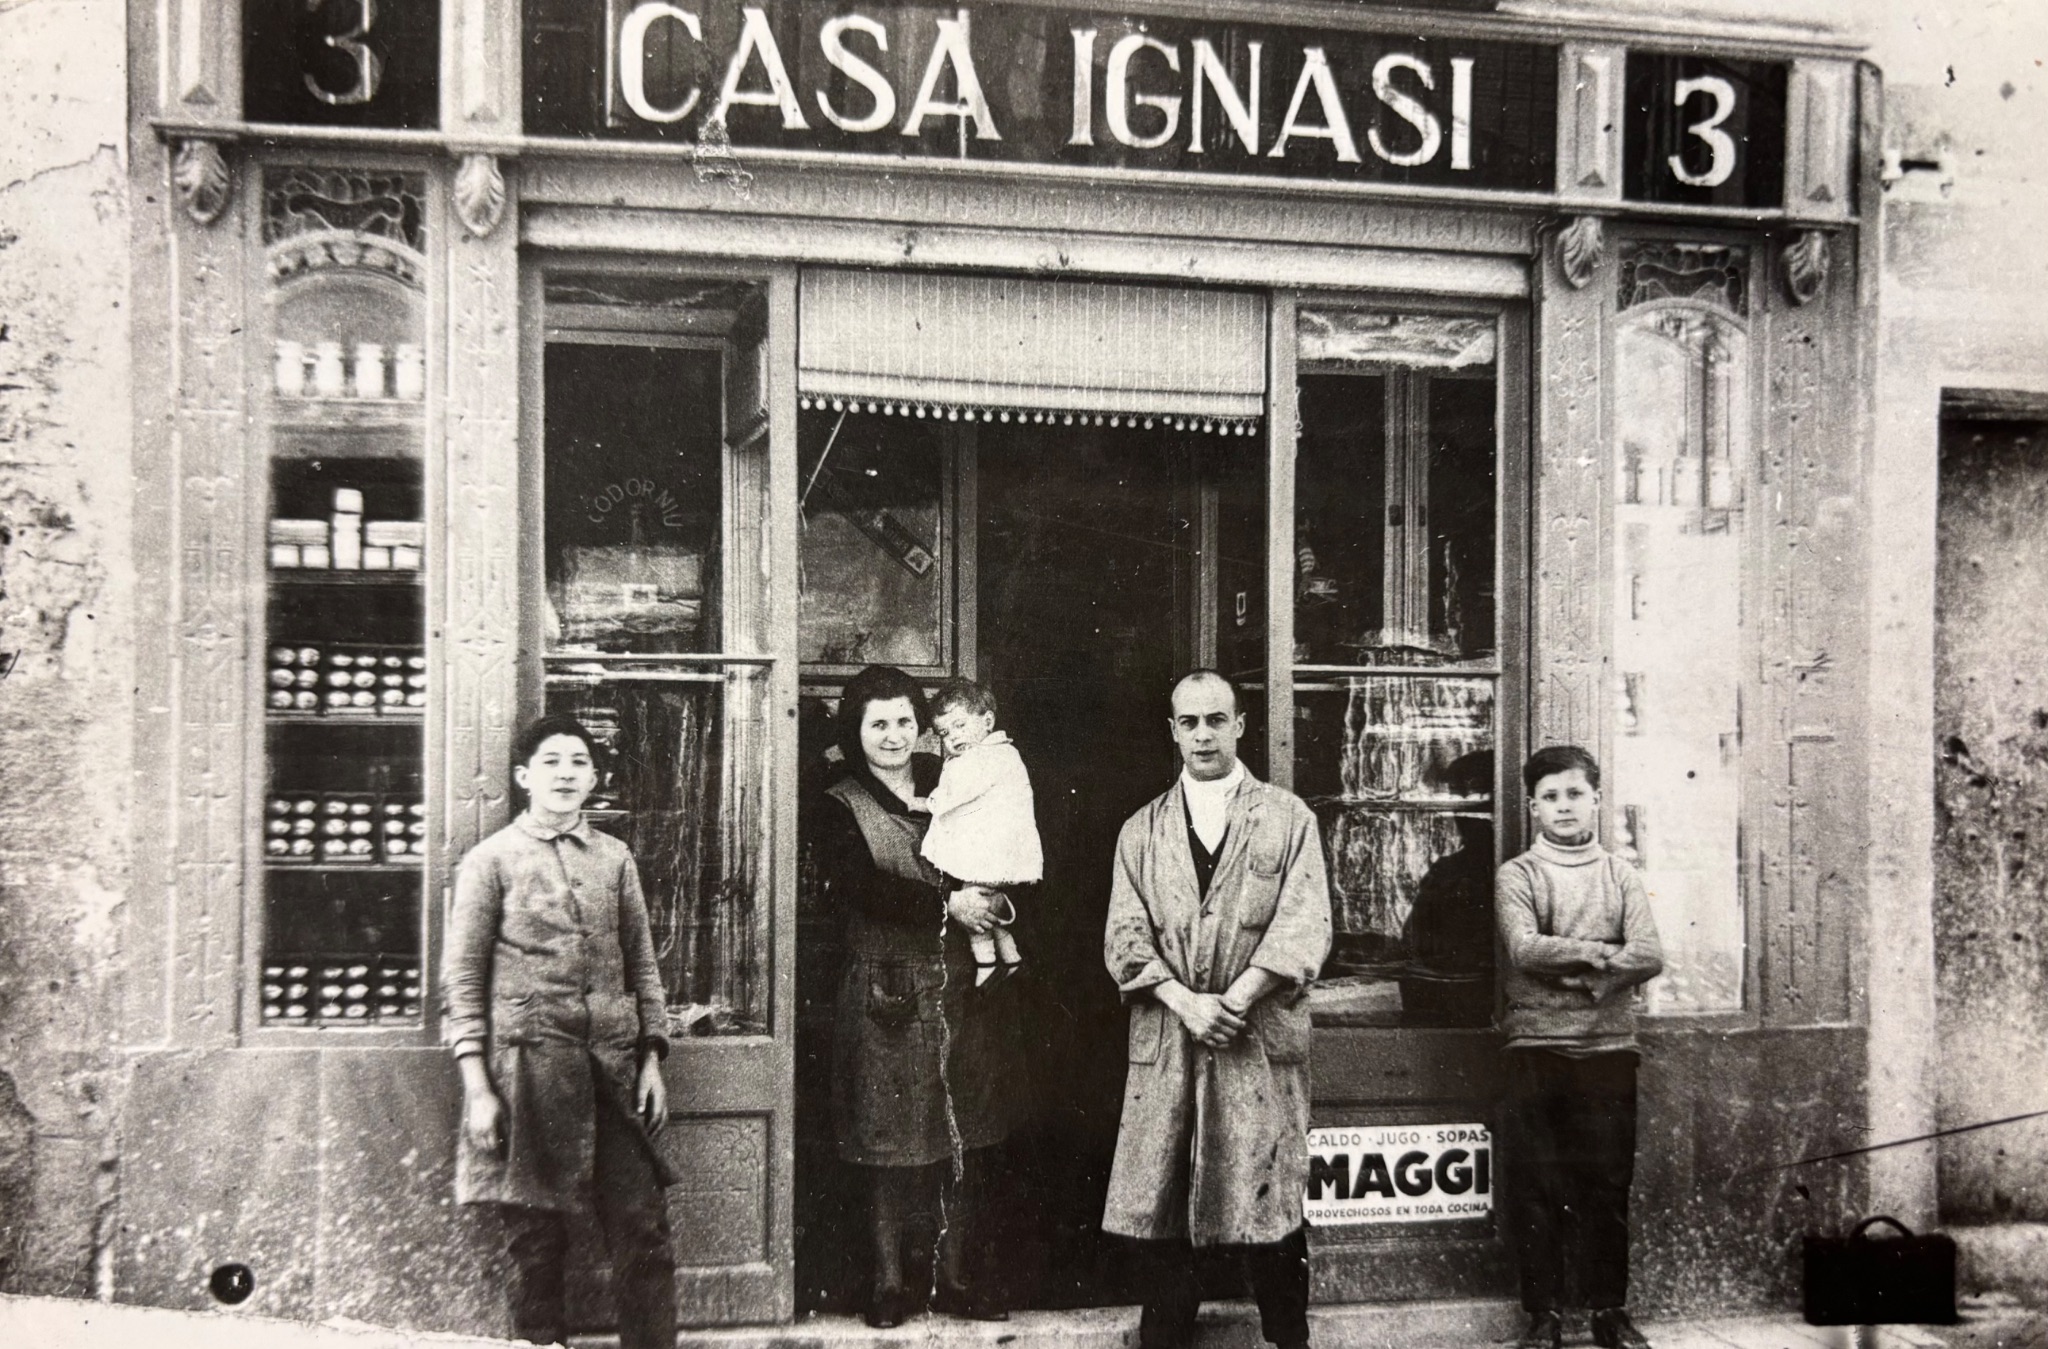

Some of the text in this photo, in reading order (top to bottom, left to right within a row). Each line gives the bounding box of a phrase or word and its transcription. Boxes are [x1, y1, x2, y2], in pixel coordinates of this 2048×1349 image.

[303, 0, 381, 105] 3
[619, 2, 1475, 170] CASA IGNASI
[1668, 75, 1736, 187] 3
[1307, 1129, 1490, 1147] CALDO JUGO SOPAS
[1307, 1148, 1490, 1200] MAGGI
[1307, 1201, 1489, 1219] PROVECHOSOS EN TODA COCINA
